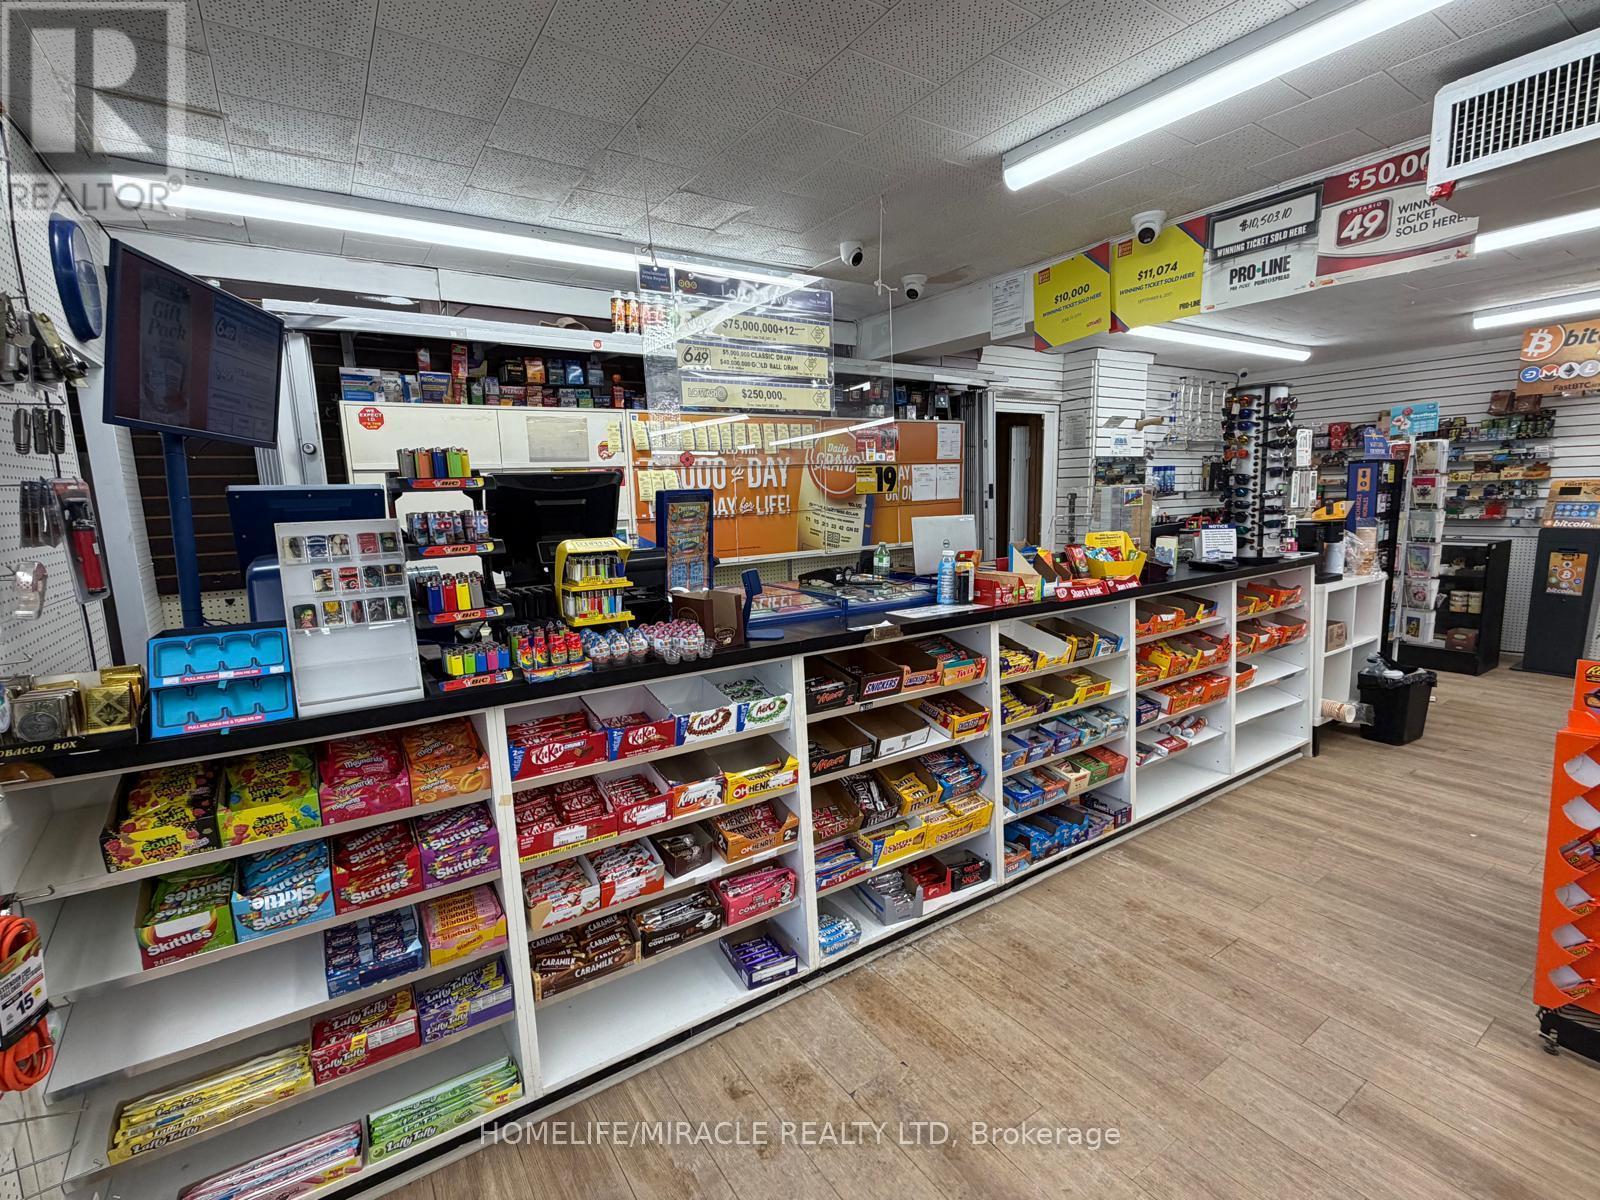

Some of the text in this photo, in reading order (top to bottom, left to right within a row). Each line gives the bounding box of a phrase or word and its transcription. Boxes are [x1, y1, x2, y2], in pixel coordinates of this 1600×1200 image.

[1347, 202, 1382, 215] ONTARIO
[1397, 207, 1438, 226] TICKET
[1239, 207, 1292, 232] $10,503.10
[1340, 209, 1385, 241] 49
[1396, 222, 1428, 237] SOLD
[1217, 225, 1307, 257] WINNING TICKET SOLD HERE
[1138, 261, 1178, 281] $11,074
[1120, 271, 1196, 295] WINNING TICKET SOLD HERE
[1054, 284, 1090, 304] $10,000
[1063, 301, 1078, 310] TICKET
[1078, 296, 1090, 306] SOLD
[152, 300, 182, 323] Gift
[148, 319, 186, 341] Pack
[751, 353, 774, 361] CLASSIC
[741, 389, 783, 400] $250,000
[1553, 381, 1591, 391] FastBTC
[828, 443, 849, 454] Daily
[747, 457, 791, 488] DAY
[876, 466, 896, 492] 19
[756, 494, 790, 516] LIFE!
[1071, 587, 1085, 598] Share
[1089, 585, 1103, 596] break
[471, 677, 489, 685] BIC
[865, 679, 898, 694] SNICKERS
[957, 718, 979, 730] SNICKERS
[629, 726, 656, 745] KitKat
[53, 740, 78, 751] BOX
[532, 743, 564, 766] KitKat
[812, 753, 847, 773] Mars
[734, 785, 748, 798] OH
[254, 813, 286, 827] SOUR
[254, 819, 289, 836] PATCH
[143, 836, 178, 851] SOUR
[430, 823, 489, 851] Skittles
[752, 837, 776, 850] HENRY!
[784, 830, 792, 841] 2
[143, 843, 182, 860] PATCH
[435, 856, 489, 880] Skittles
[351, 878, 409, 904] Skittles
[738, 897, 776, 916] COW TALES
[253, 902, 319, 931] Skittles
[588, 914, 618, 933] CARAMILK
[147, 928, 213, 956] Skittles
[531, 932, 565, 949] CARAMILK
[589, 933, 620, 950] CARAMILK
[648, 933, 680, 948] COW TALES
[541, 956, 576, 967] CARAMILK
[575, 956, 614, 978] CARAMILK
[16, 992, 34, 1016] 15
[332, 1000, 387, 1029] Laffy Taffy
[425, 1020, 449, 1035] Laffy
[318, 1047, 366, 1072] Laffy Taffy
[131, 1125, 200, 1155] Laffy Taffy
[385, 1124, 437, 1153] Laffy Taffy
